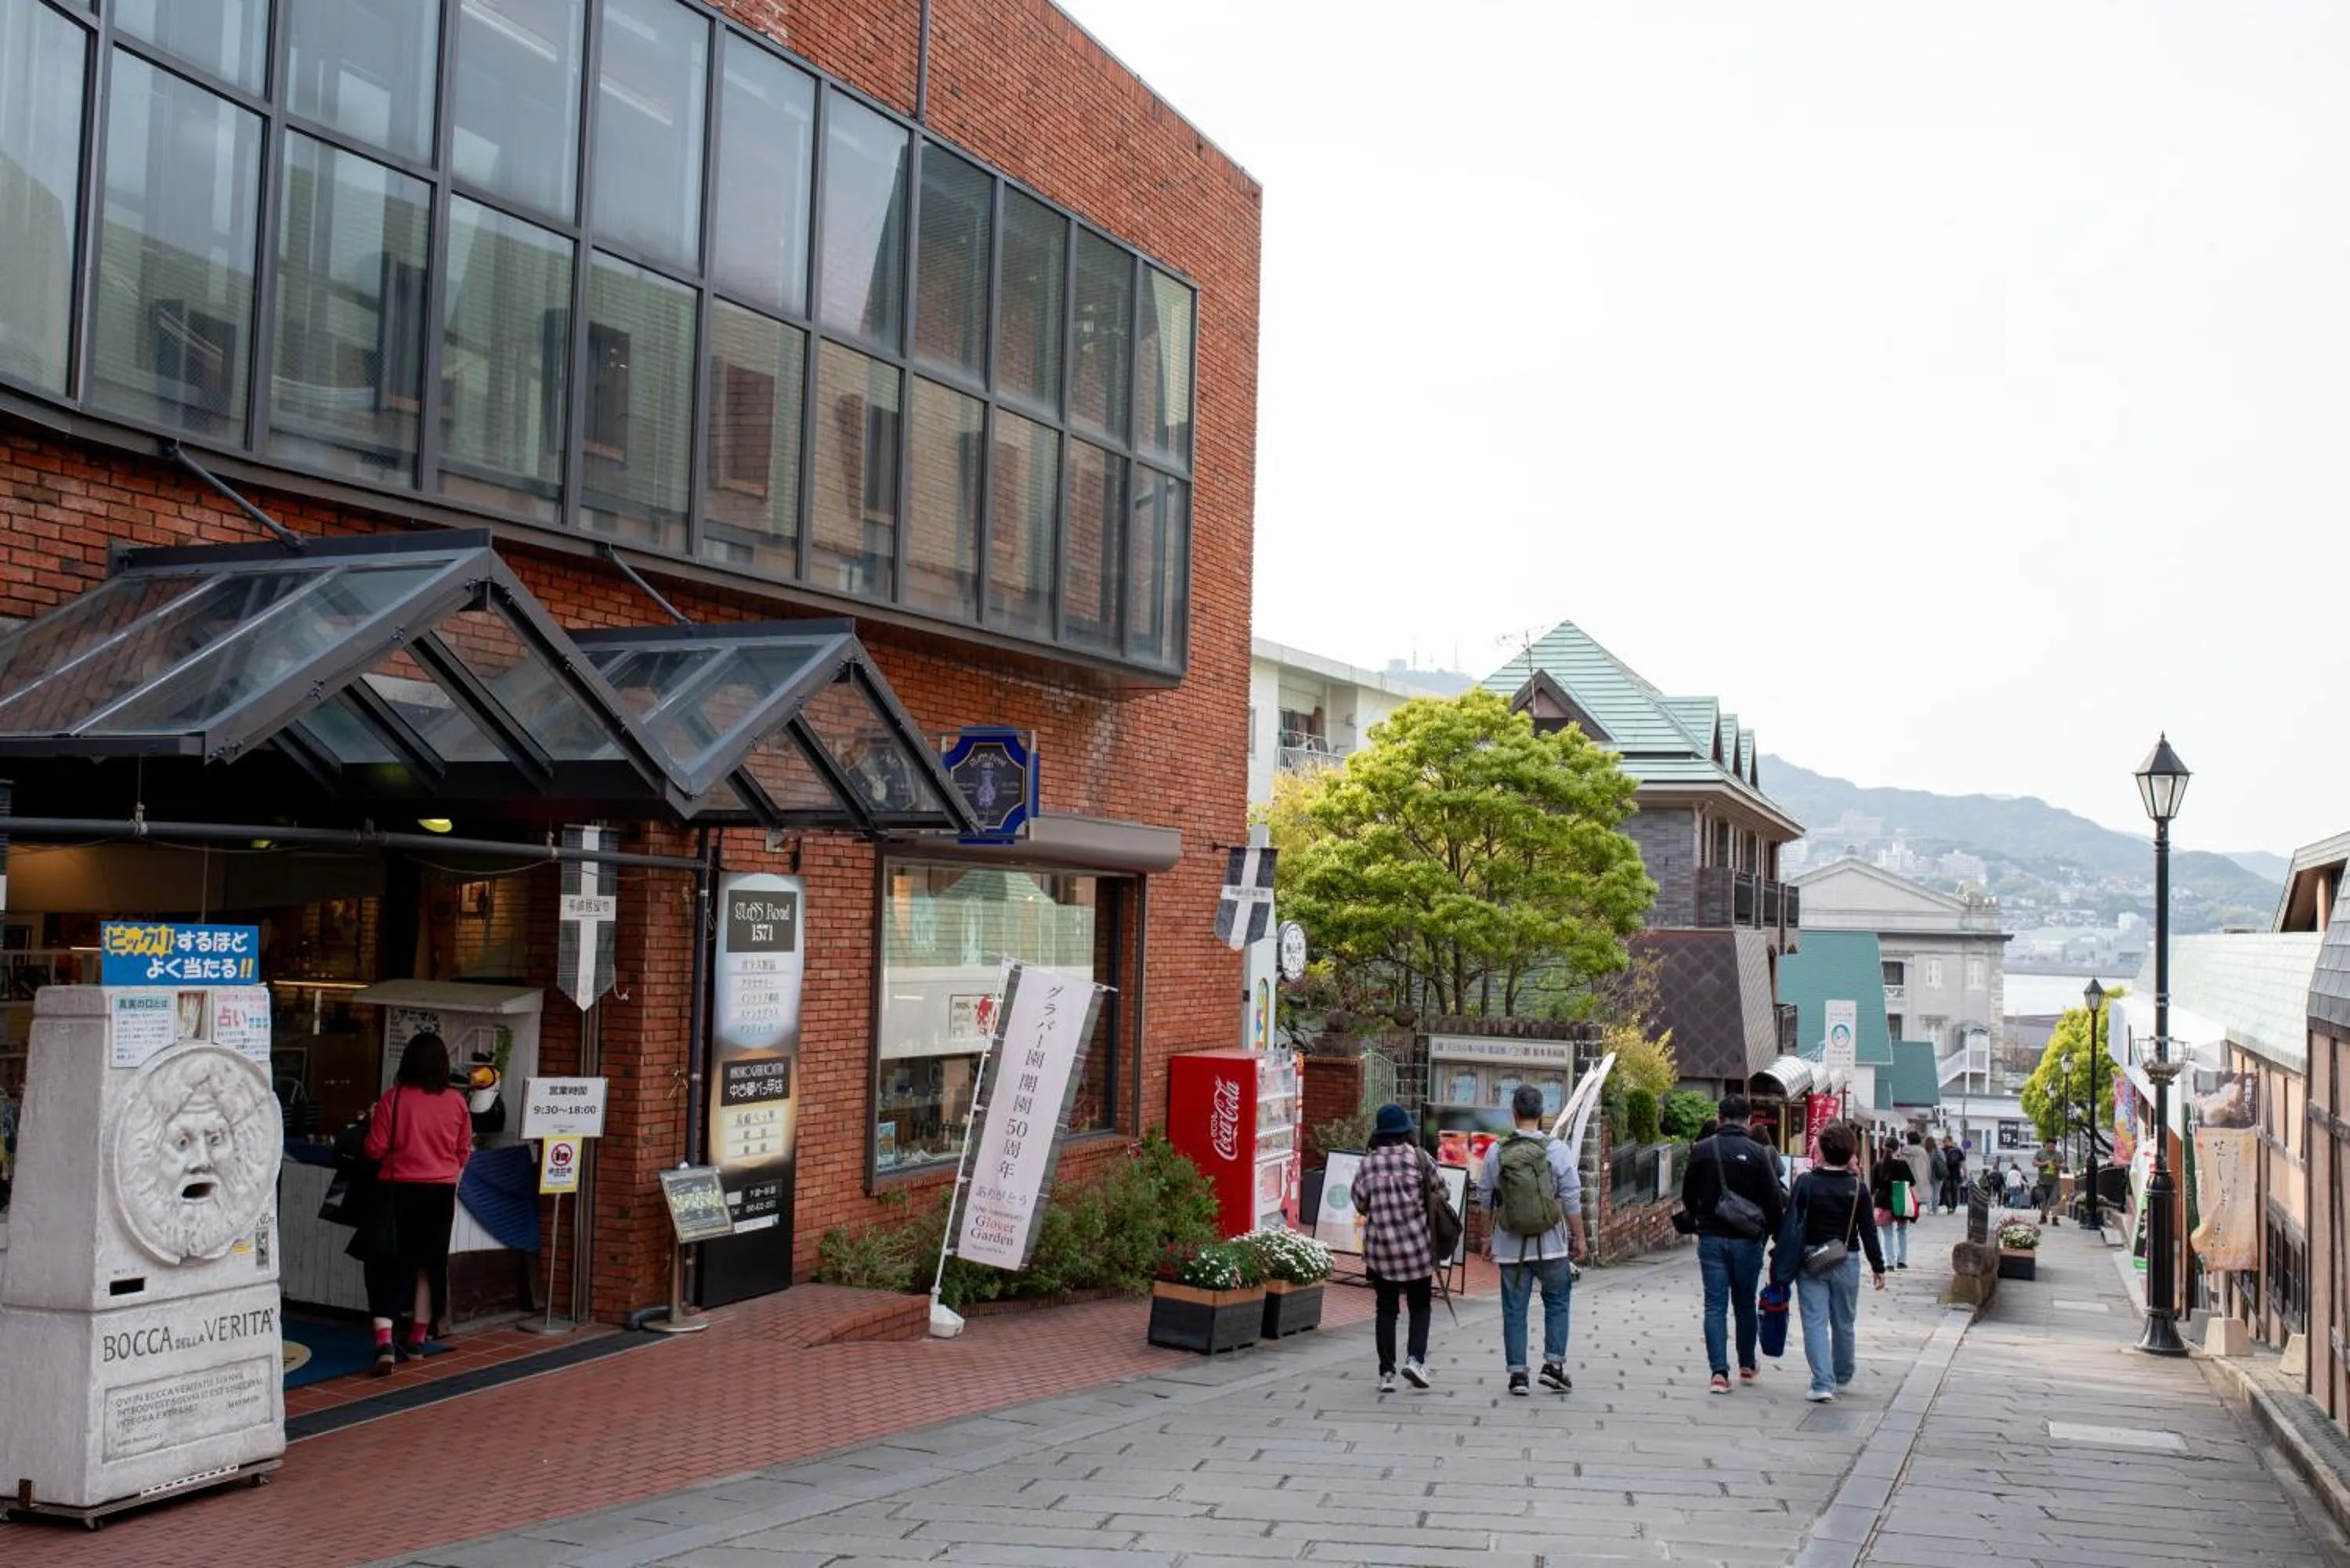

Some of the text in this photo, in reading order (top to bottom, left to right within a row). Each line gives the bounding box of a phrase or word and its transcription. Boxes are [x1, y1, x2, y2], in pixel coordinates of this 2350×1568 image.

[751, 924, 773, 941] 1571
[217, 1006, 247, 1028] 占い
[975, 1215, 1016, 1234] Glover
[971, 1228, 1014, 1247] Garden
[103, 1327, 174, 1362] BOCCA
